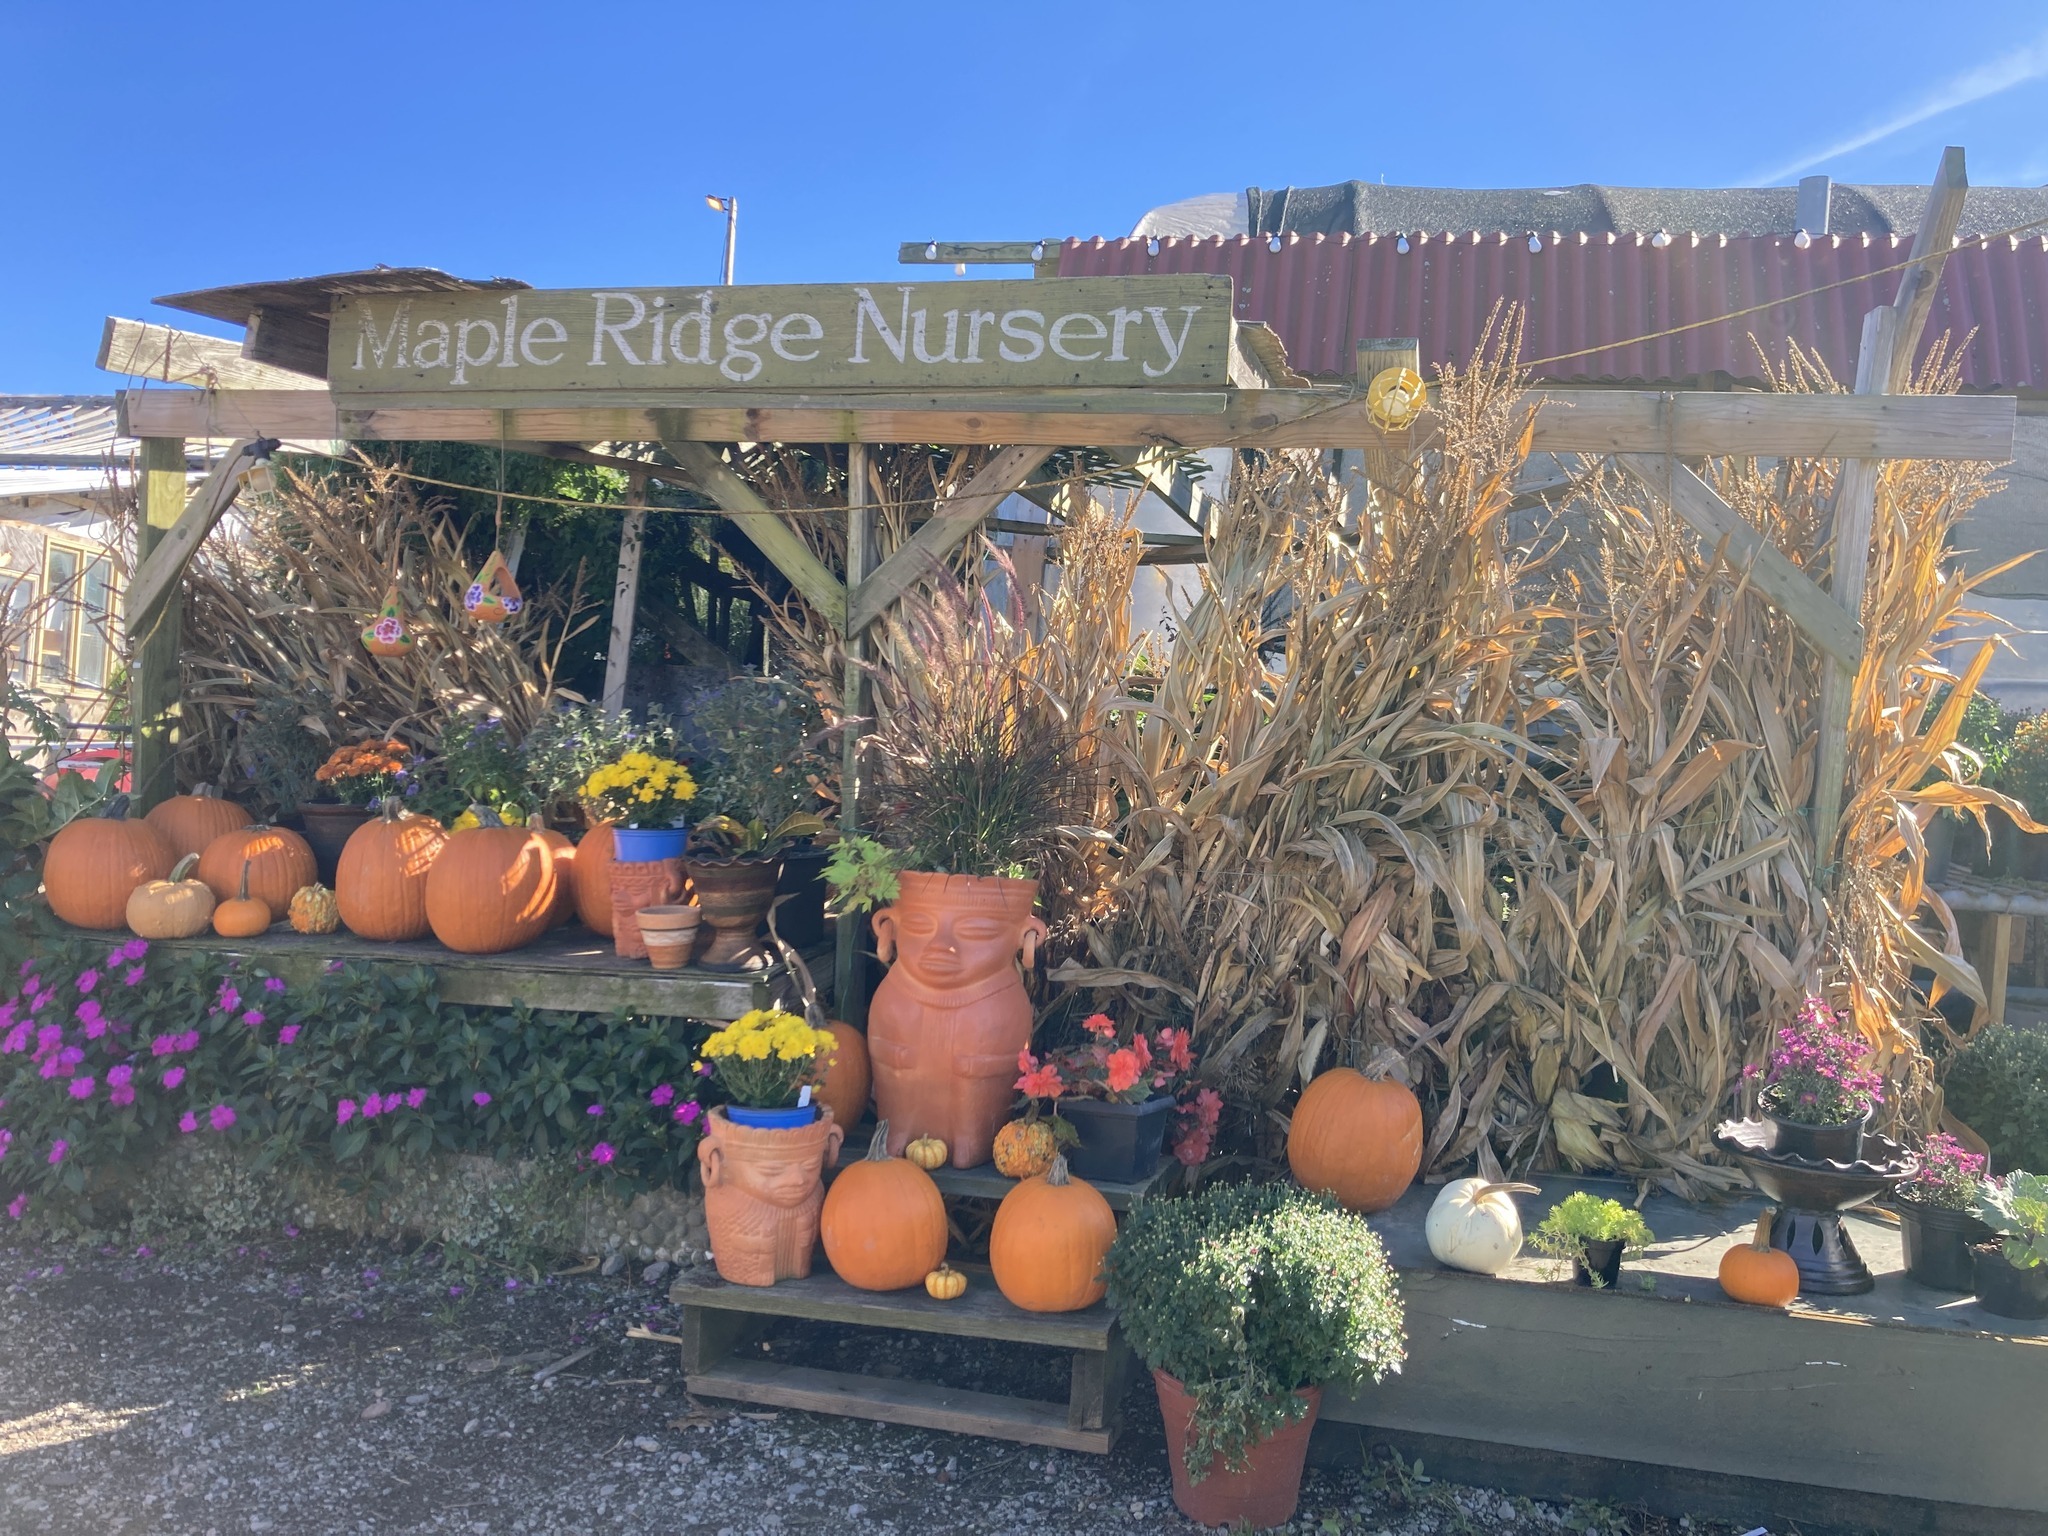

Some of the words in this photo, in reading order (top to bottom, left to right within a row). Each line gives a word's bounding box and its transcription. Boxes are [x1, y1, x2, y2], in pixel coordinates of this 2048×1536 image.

[352, 294, 568, 386] Maple
[587, 289, 824, 382] Ridge
[847, 287, 1202, 377] Nursery
